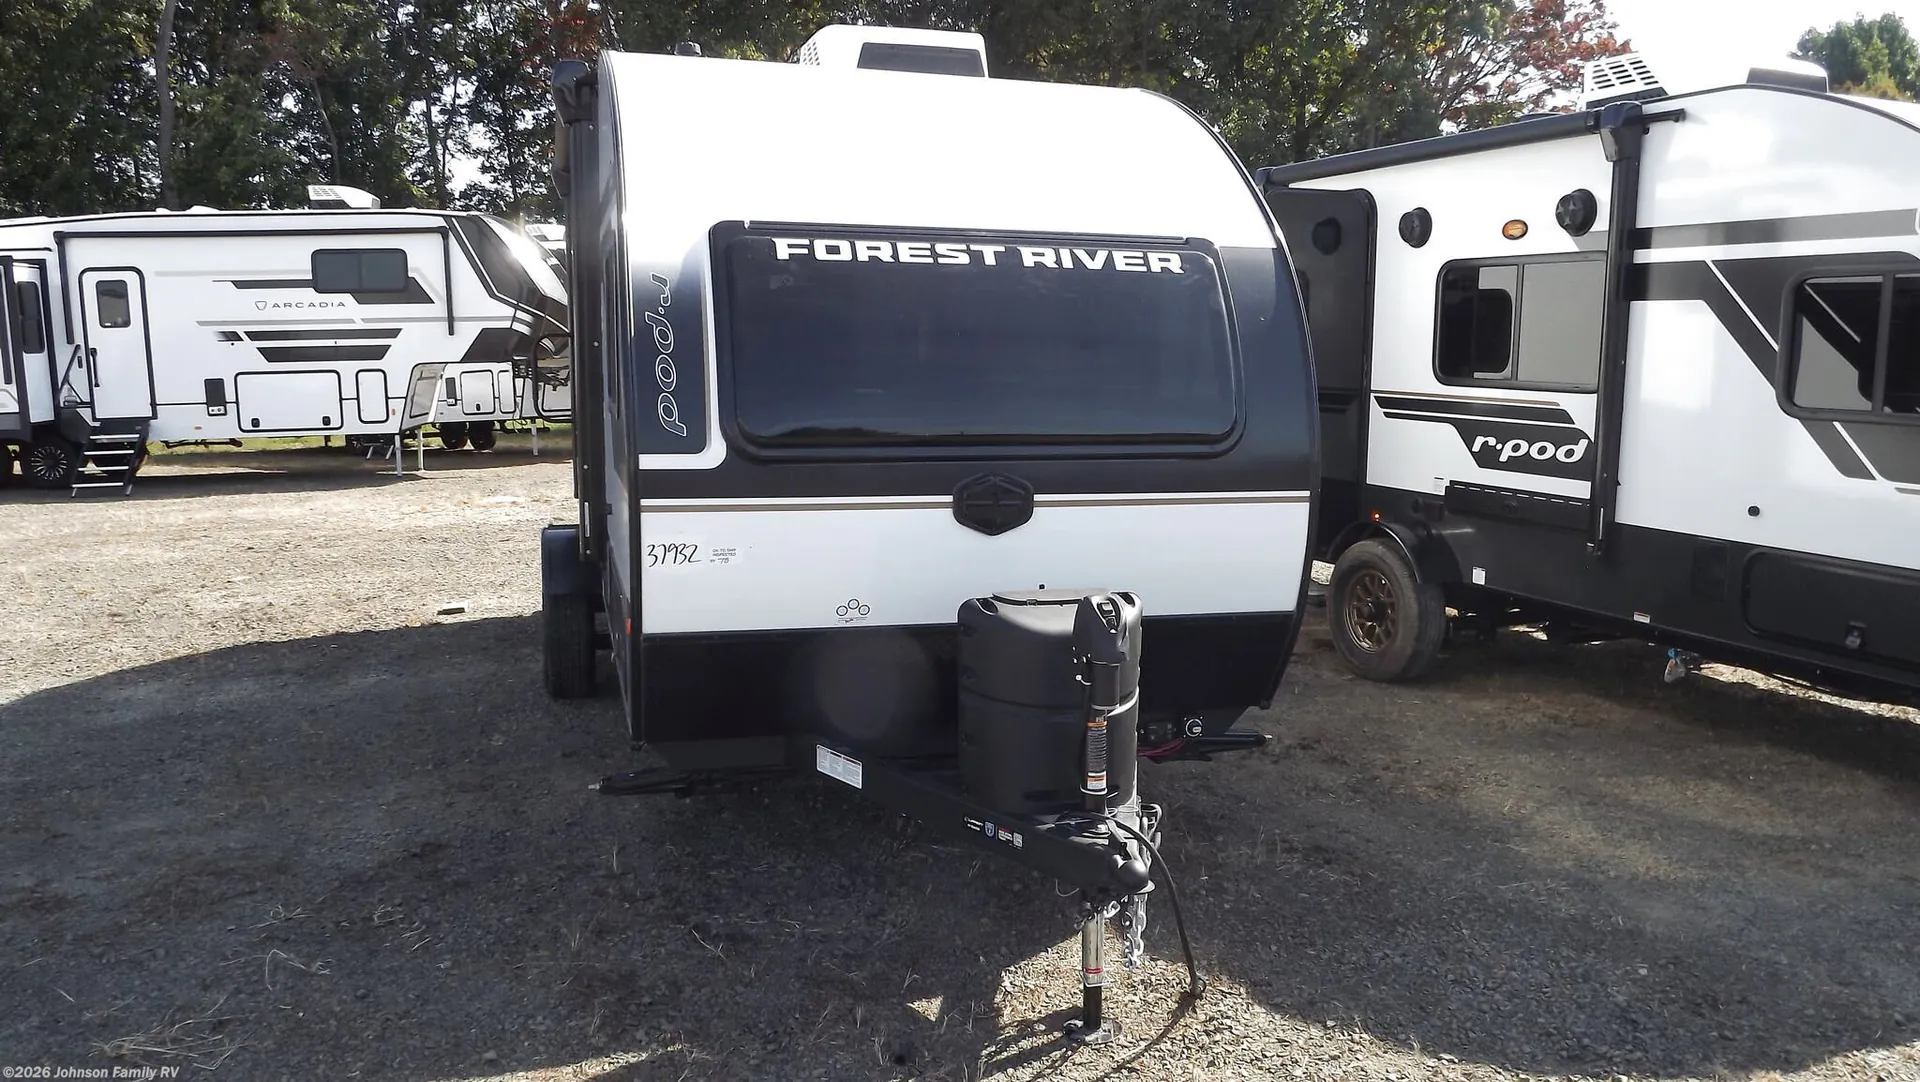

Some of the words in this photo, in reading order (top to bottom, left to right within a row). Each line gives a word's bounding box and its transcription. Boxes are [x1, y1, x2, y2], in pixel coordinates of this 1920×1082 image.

[772, 238, 1005, 266] FOREST
[1017, 246, 1184, 274] RIVER
[646, 543, 702, 568] 37932
